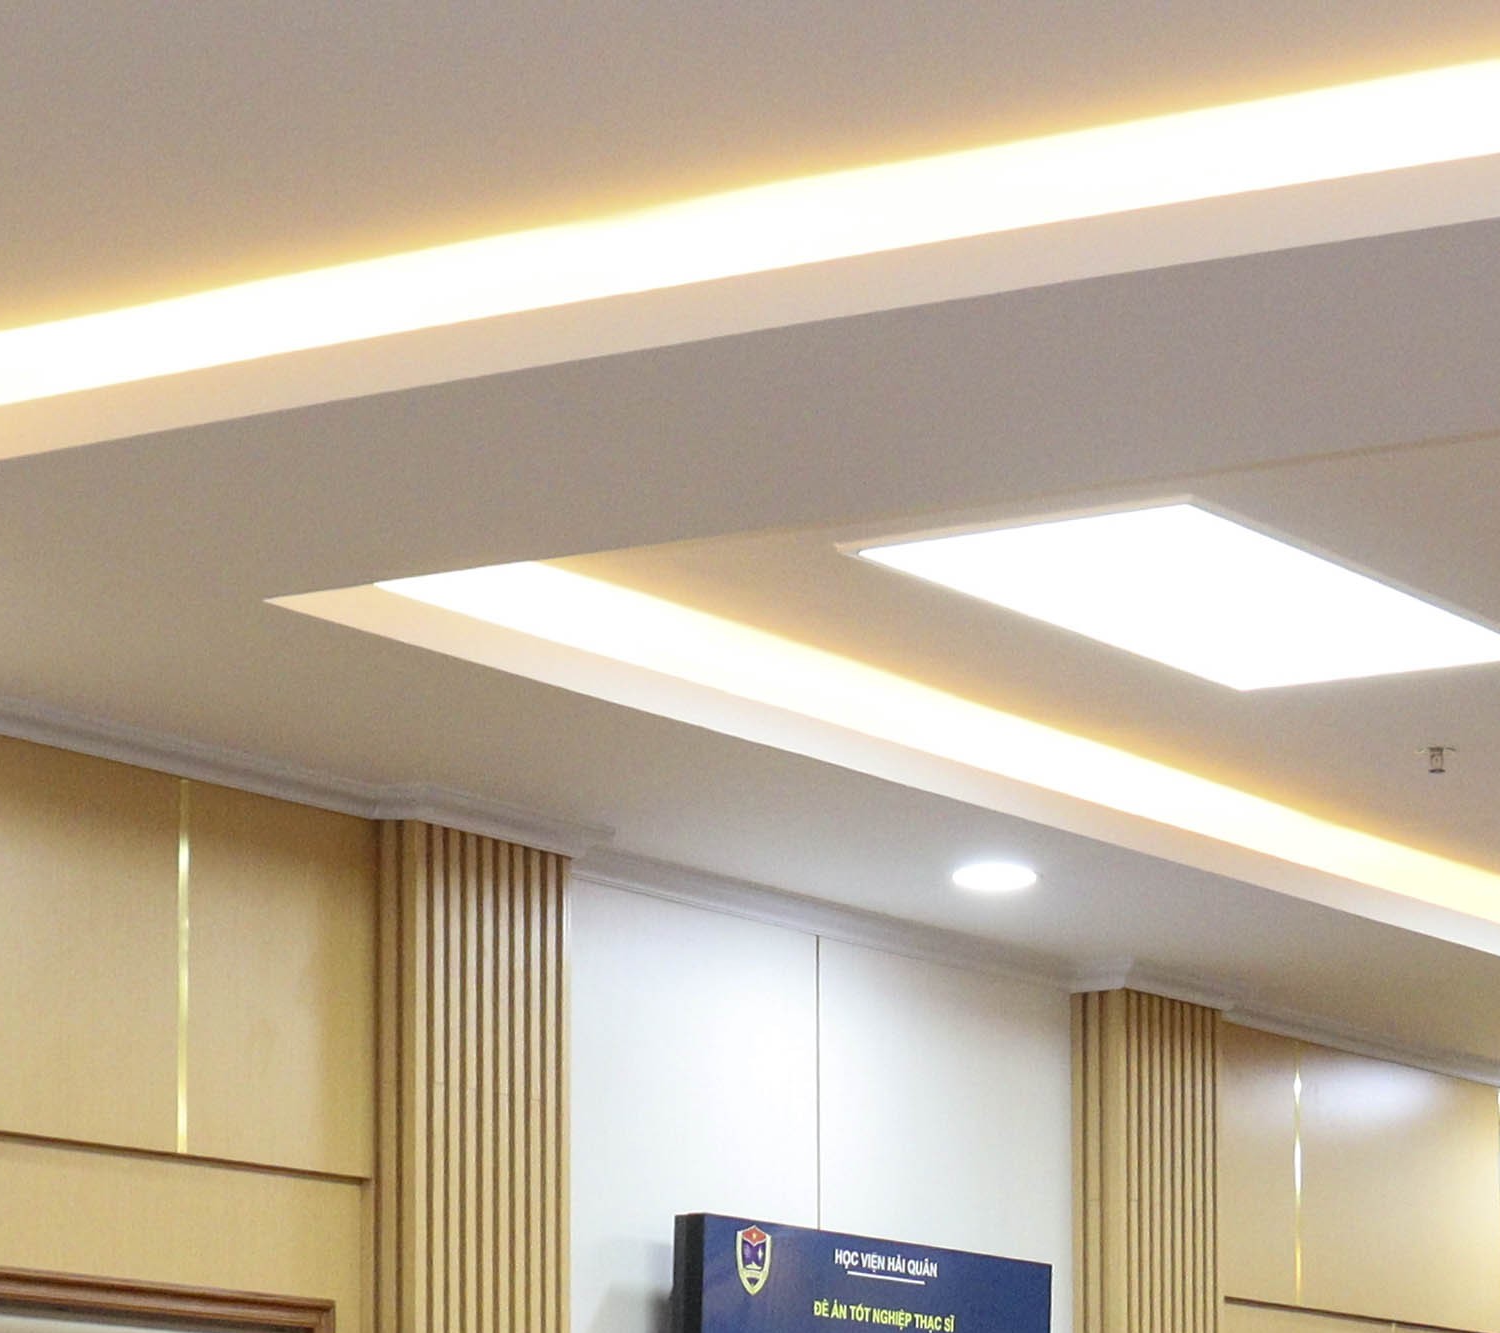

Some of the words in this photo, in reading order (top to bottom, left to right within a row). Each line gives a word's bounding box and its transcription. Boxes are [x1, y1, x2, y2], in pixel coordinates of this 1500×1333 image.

[835, 1249, 859, 1269] HỌC
[861, 1253, 885, 1272] VIỆN
[887, 1255, 905, 1273] HẢI
[907, 1258, 937, 1277] QUÂN
